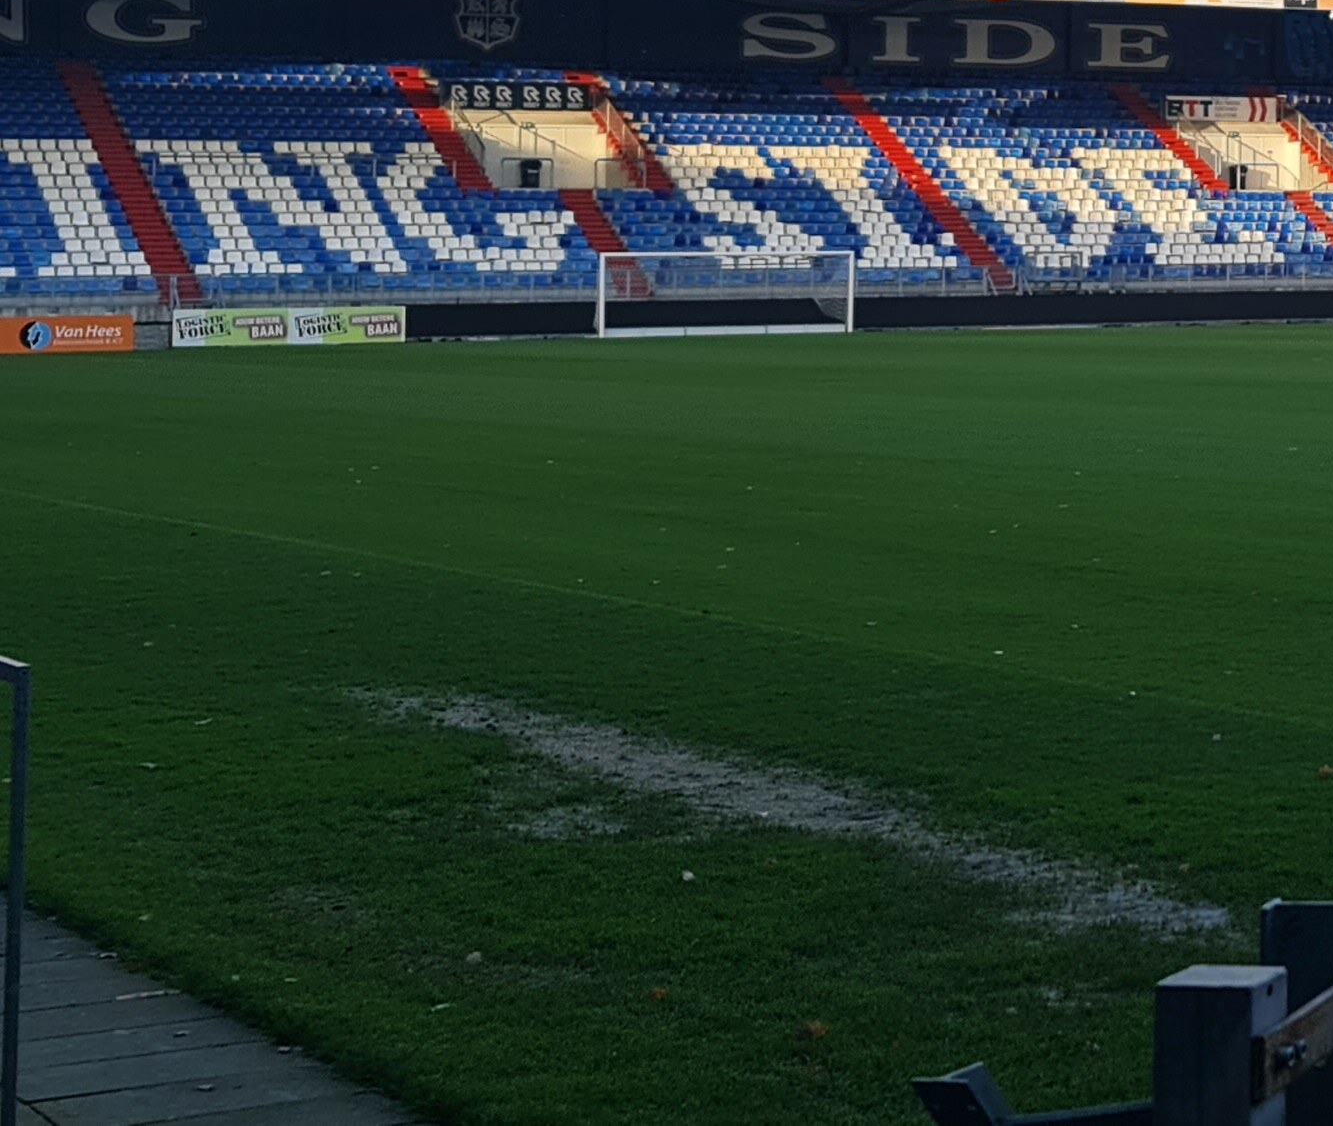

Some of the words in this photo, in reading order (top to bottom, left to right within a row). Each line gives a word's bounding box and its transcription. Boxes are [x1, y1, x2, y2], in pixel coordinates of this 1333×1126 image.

[742, 12, 1172, 70] SIDE
[0, 139, 575, 274] ING
[55, 325, 83, 338] Van
[86, 324, 122, 337] Hees
[251, 325, 284, 338] BAAN
[367, 323, 398, 336] BAAN
